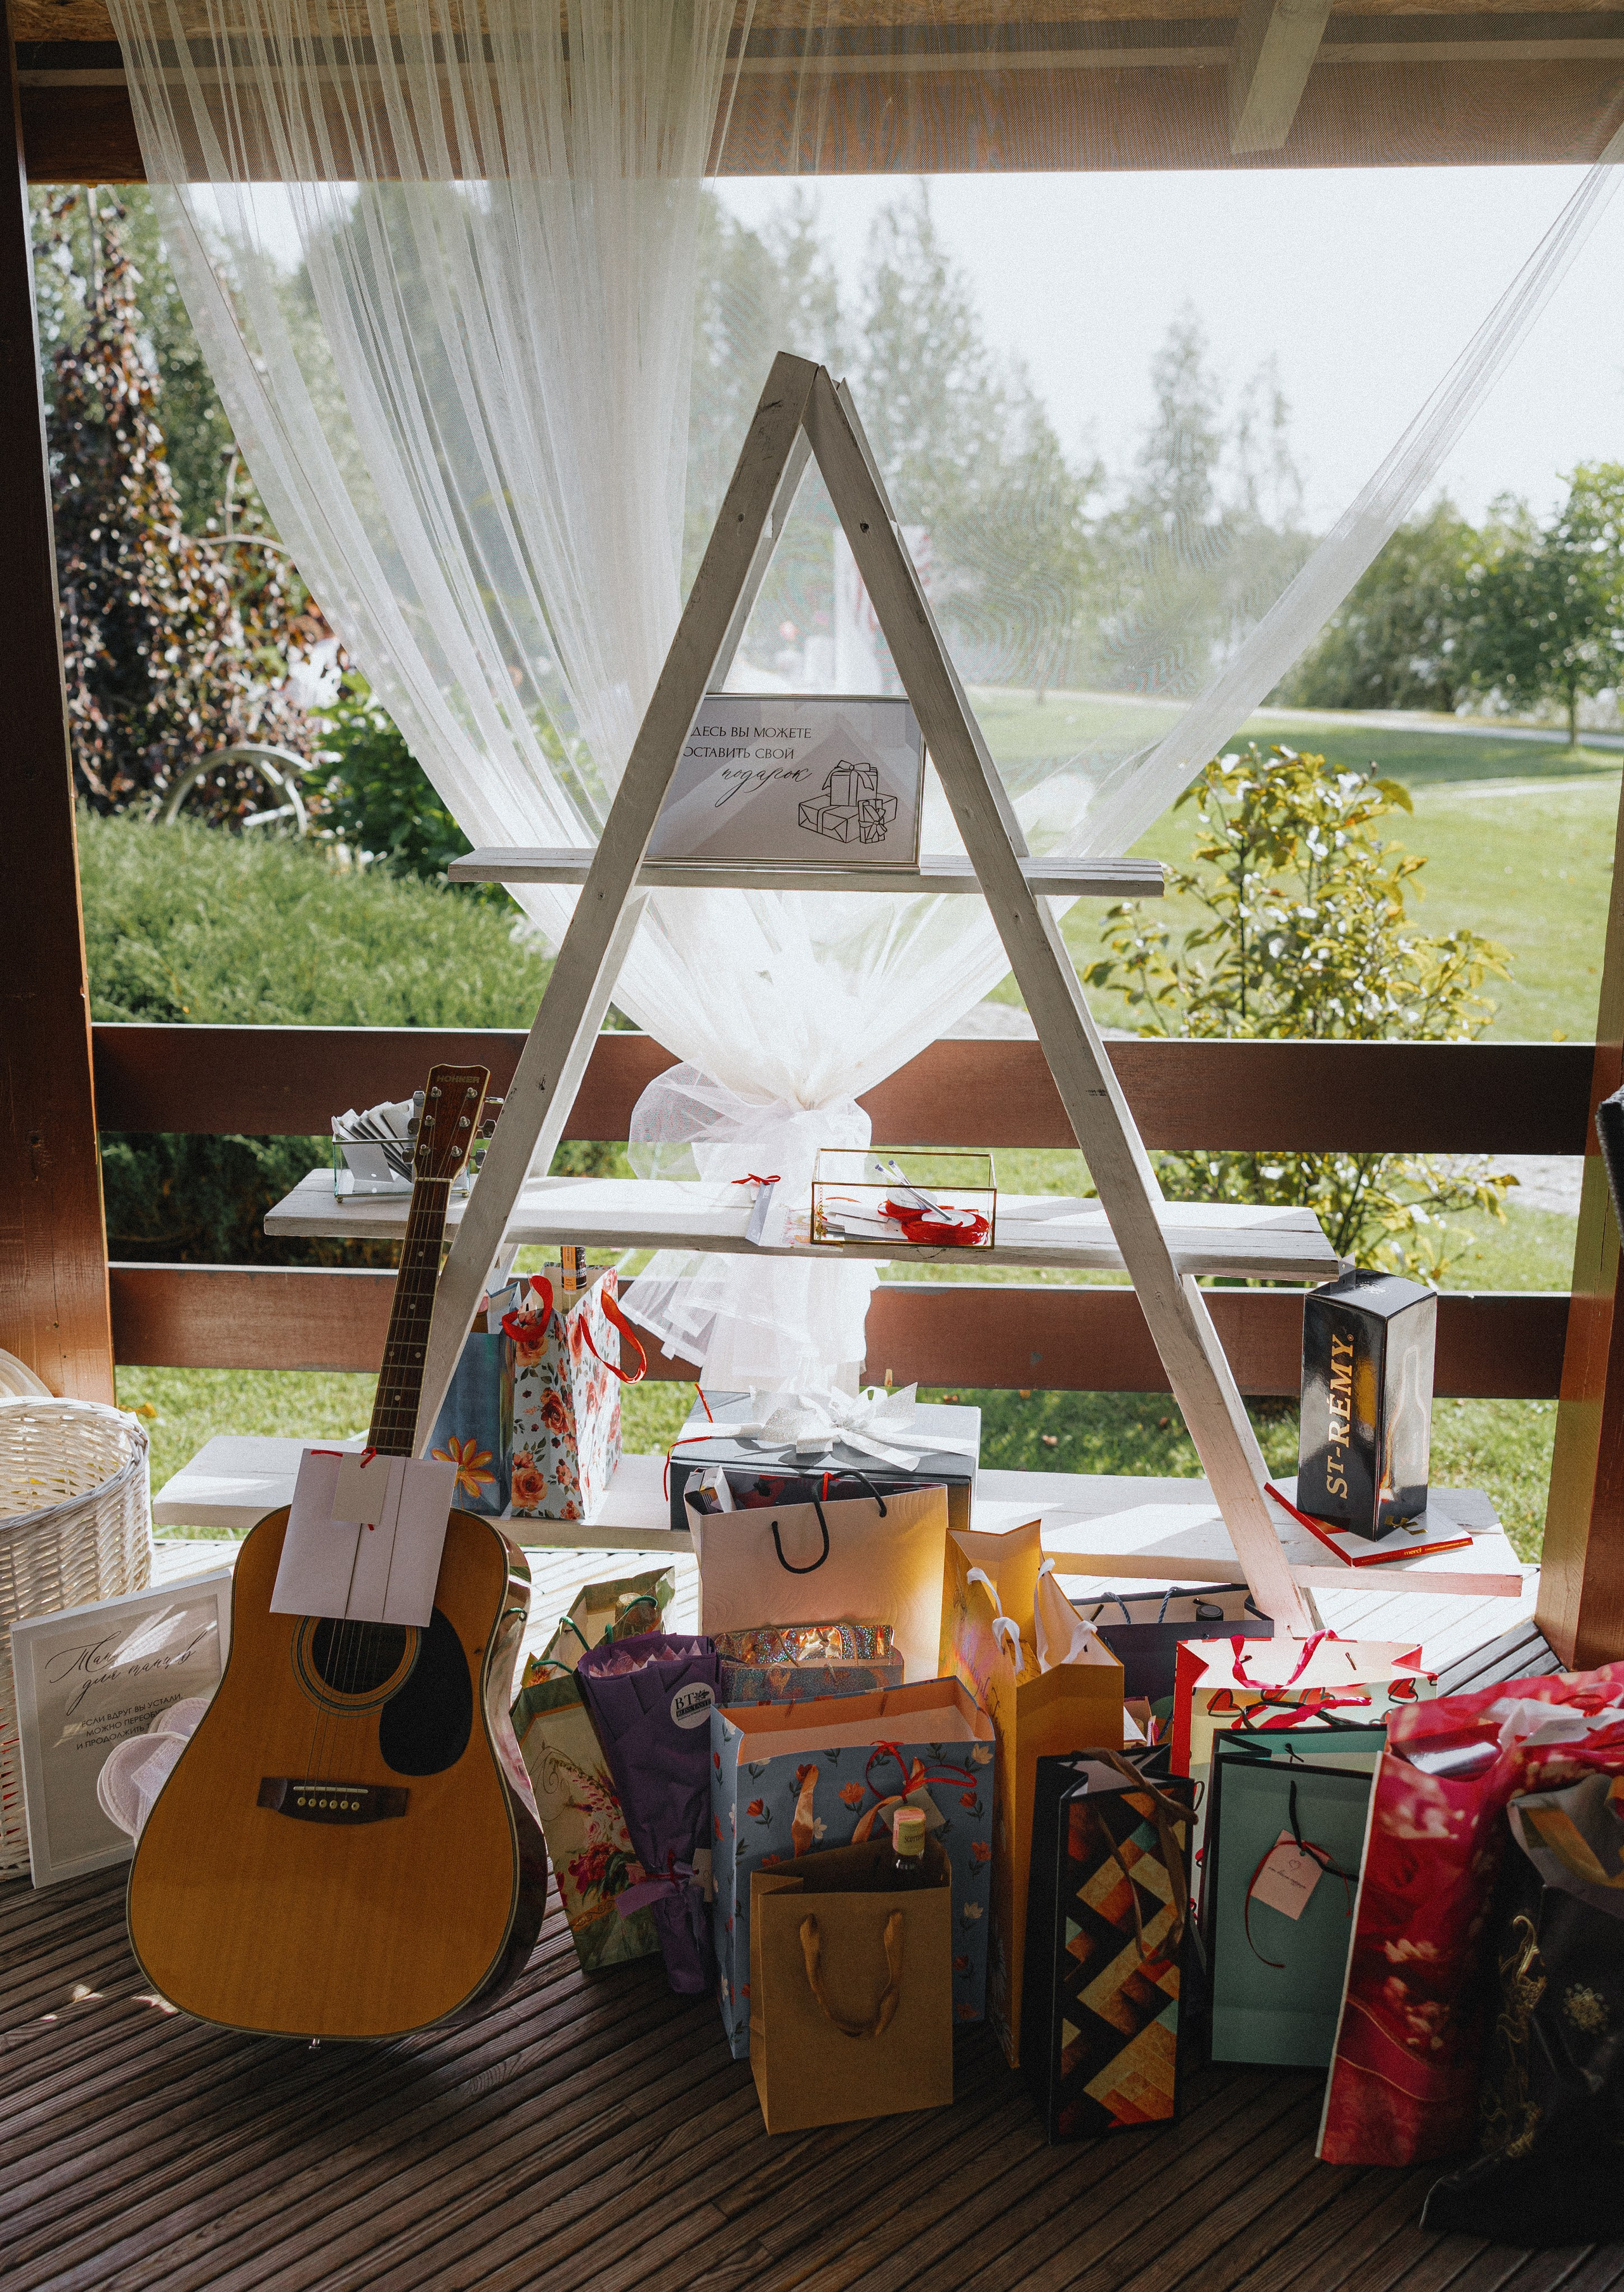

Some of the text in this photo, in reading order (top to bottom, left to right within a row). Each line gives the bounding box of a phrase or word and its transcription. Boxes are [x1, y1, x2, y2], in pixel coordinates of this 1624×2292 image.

[690, 726, 812, 738] ДЕСЬ ВЫ МОЖЕТЕ
[683, 747, 794, 759] ОСТАВИТЬ СВОЙ
[715, 767, 813, 808] подарок
[436, 1075, 480, 1084] HOHNER
[1404, 1547, 1422, 1556] merci
[128, 1630, 207, 1676] танцв
[674, 1692, 695, 1710] BT
[81, 1693, 183, 1728] ЕСЛИ ВДРУГ ВЫ УСТАЛИ,
[85, 1725, 145, 1748] ПРОДОЛЖИТЬ
[86, 1721, 122, 1737] МОЖНО
